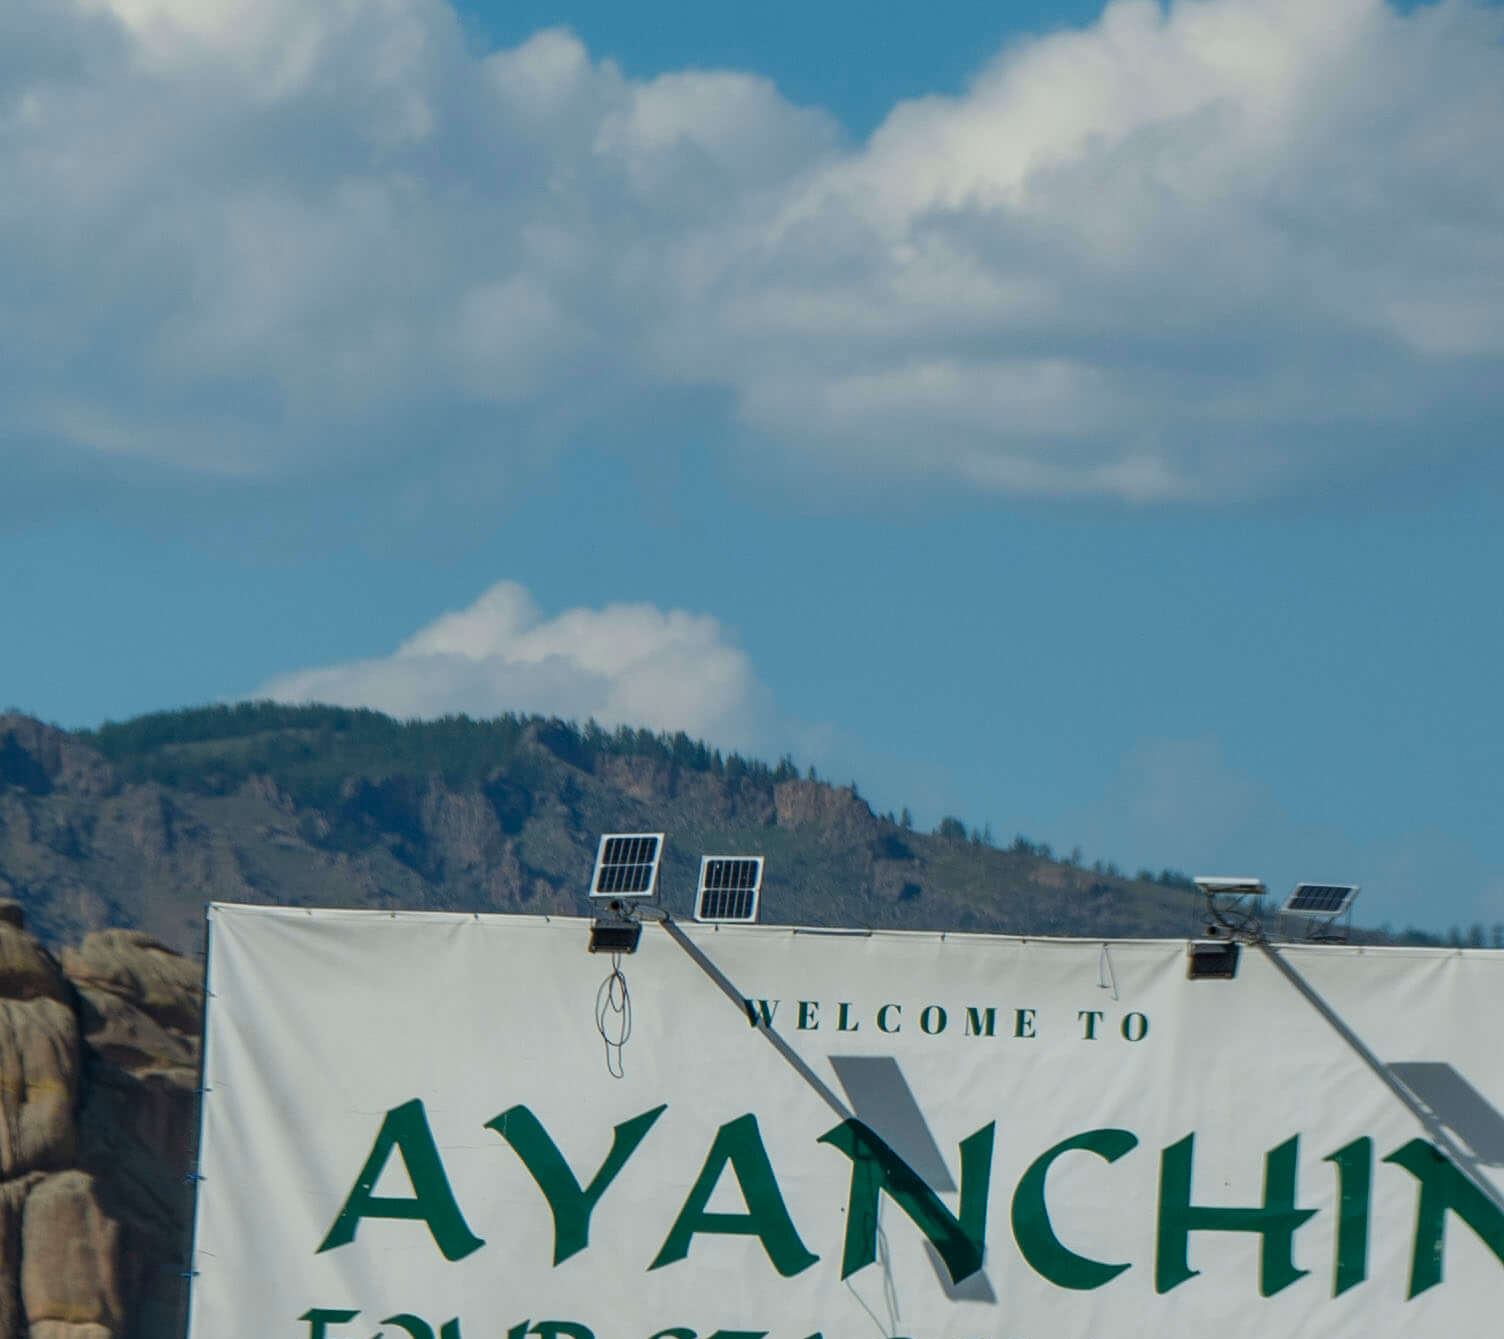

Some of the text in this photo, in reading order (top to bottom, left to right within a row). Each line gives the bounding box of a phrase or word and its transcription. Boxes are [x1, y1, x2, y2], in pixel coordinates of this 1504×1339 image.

[744, 998, 1149, 1042] WELCOME TO
[314, 1098, 1504, 1302] AYANCHIN
